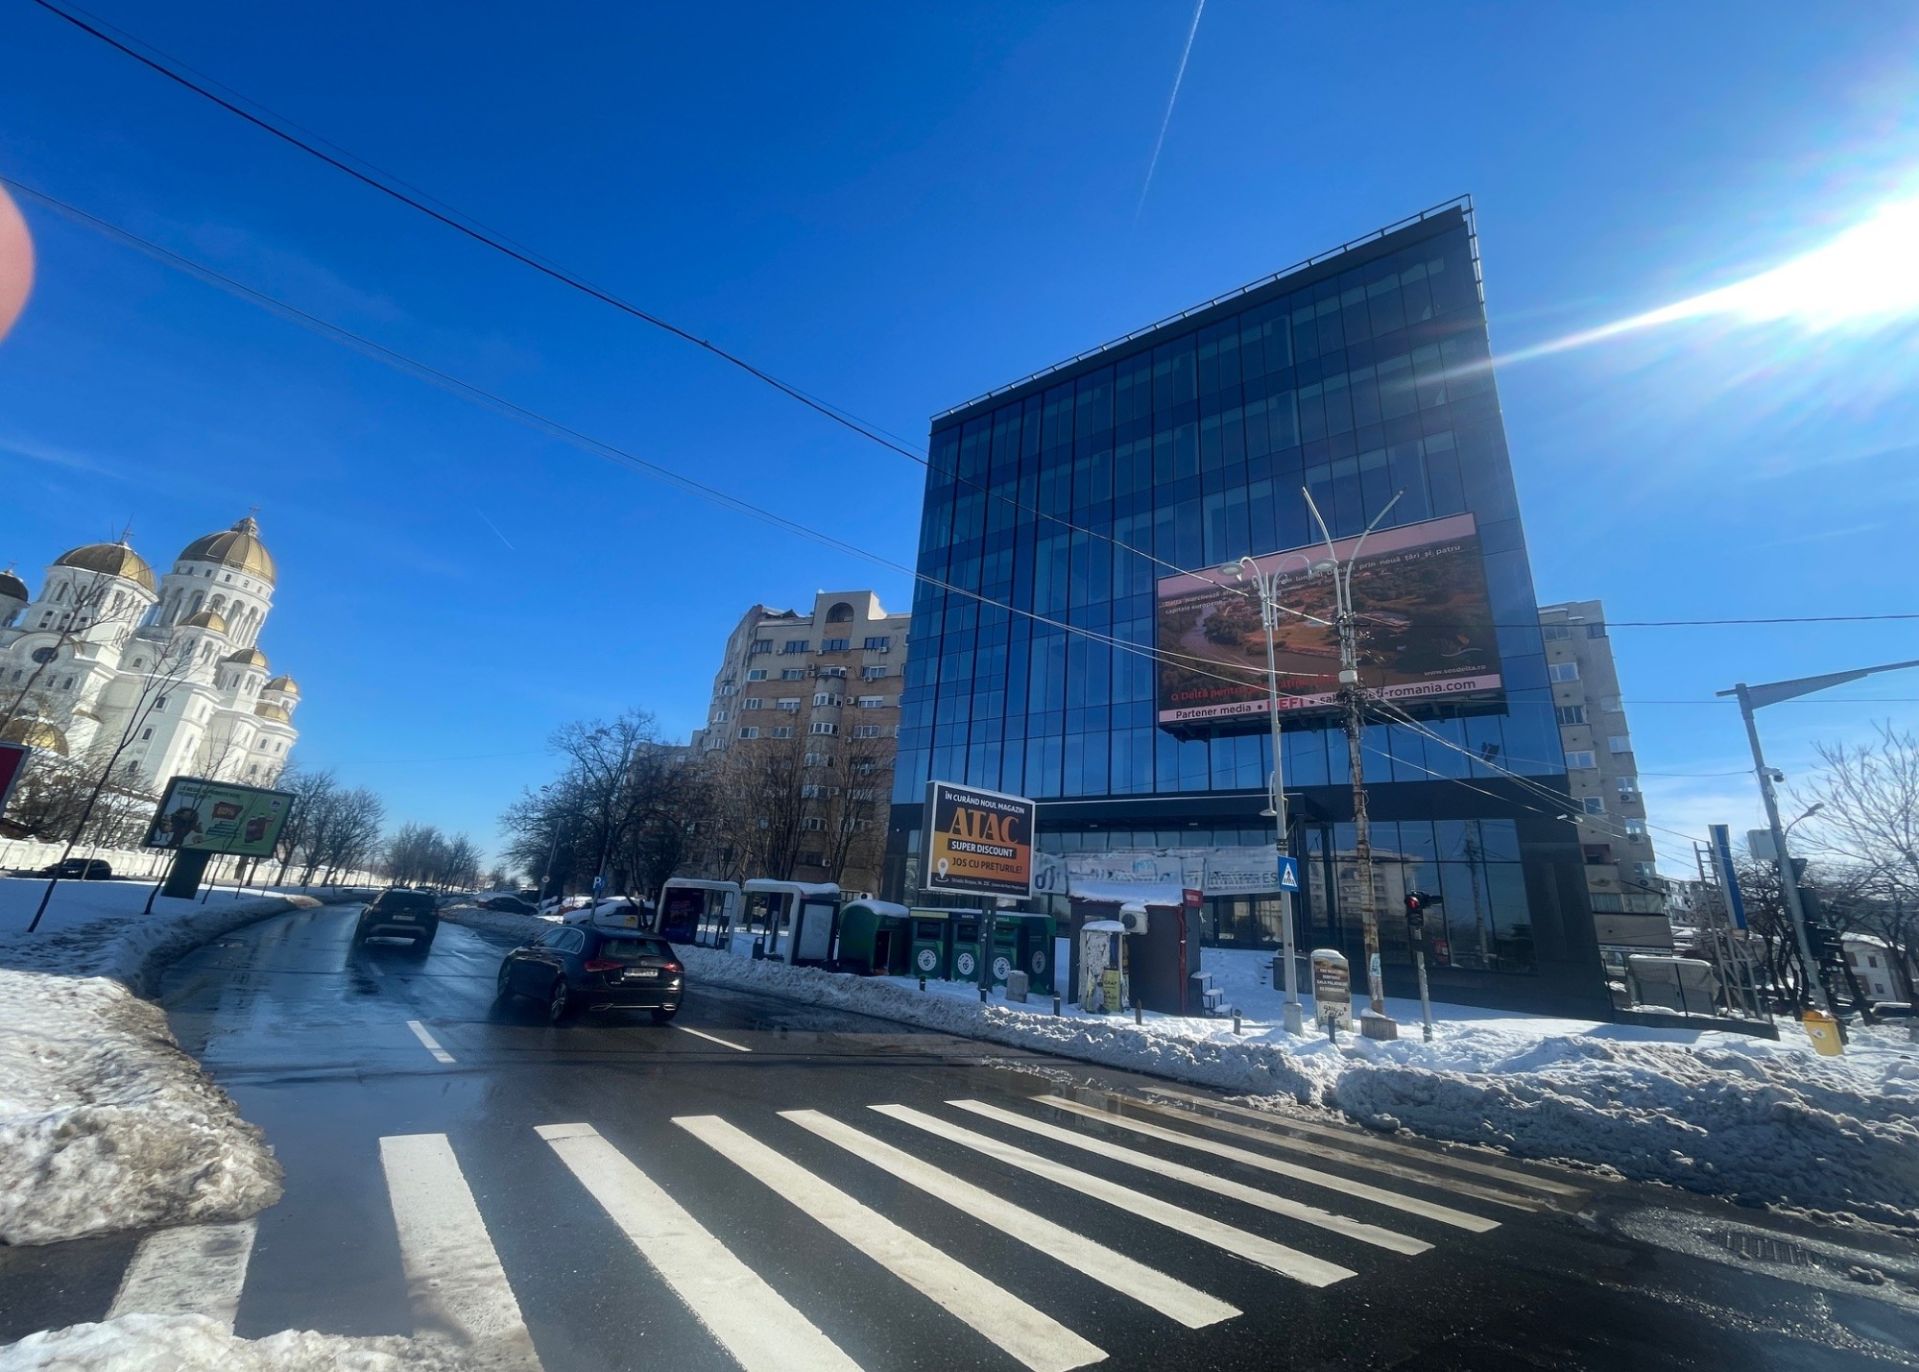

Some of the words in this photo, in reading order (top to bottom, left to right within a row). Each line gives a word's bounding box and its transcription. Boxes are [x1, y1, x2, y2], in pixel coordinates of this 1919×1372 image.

[1176, 707, 1218, 719] Partener
[1220, 704, 1252, 715] media
[953, 794, 980, 806] CURÂND
[981, 799, 998, 809] NOUL
[998, 803, 1025, 814] MAGAZIN
[949, 806, 1020, 844] ATAC
[951, 841, 976, 853] SUPER
[977, 845, 1014, 857] DISCOUNT
[952, 857, 967, 867] JOS
[968, 859, 980, 869] CU
